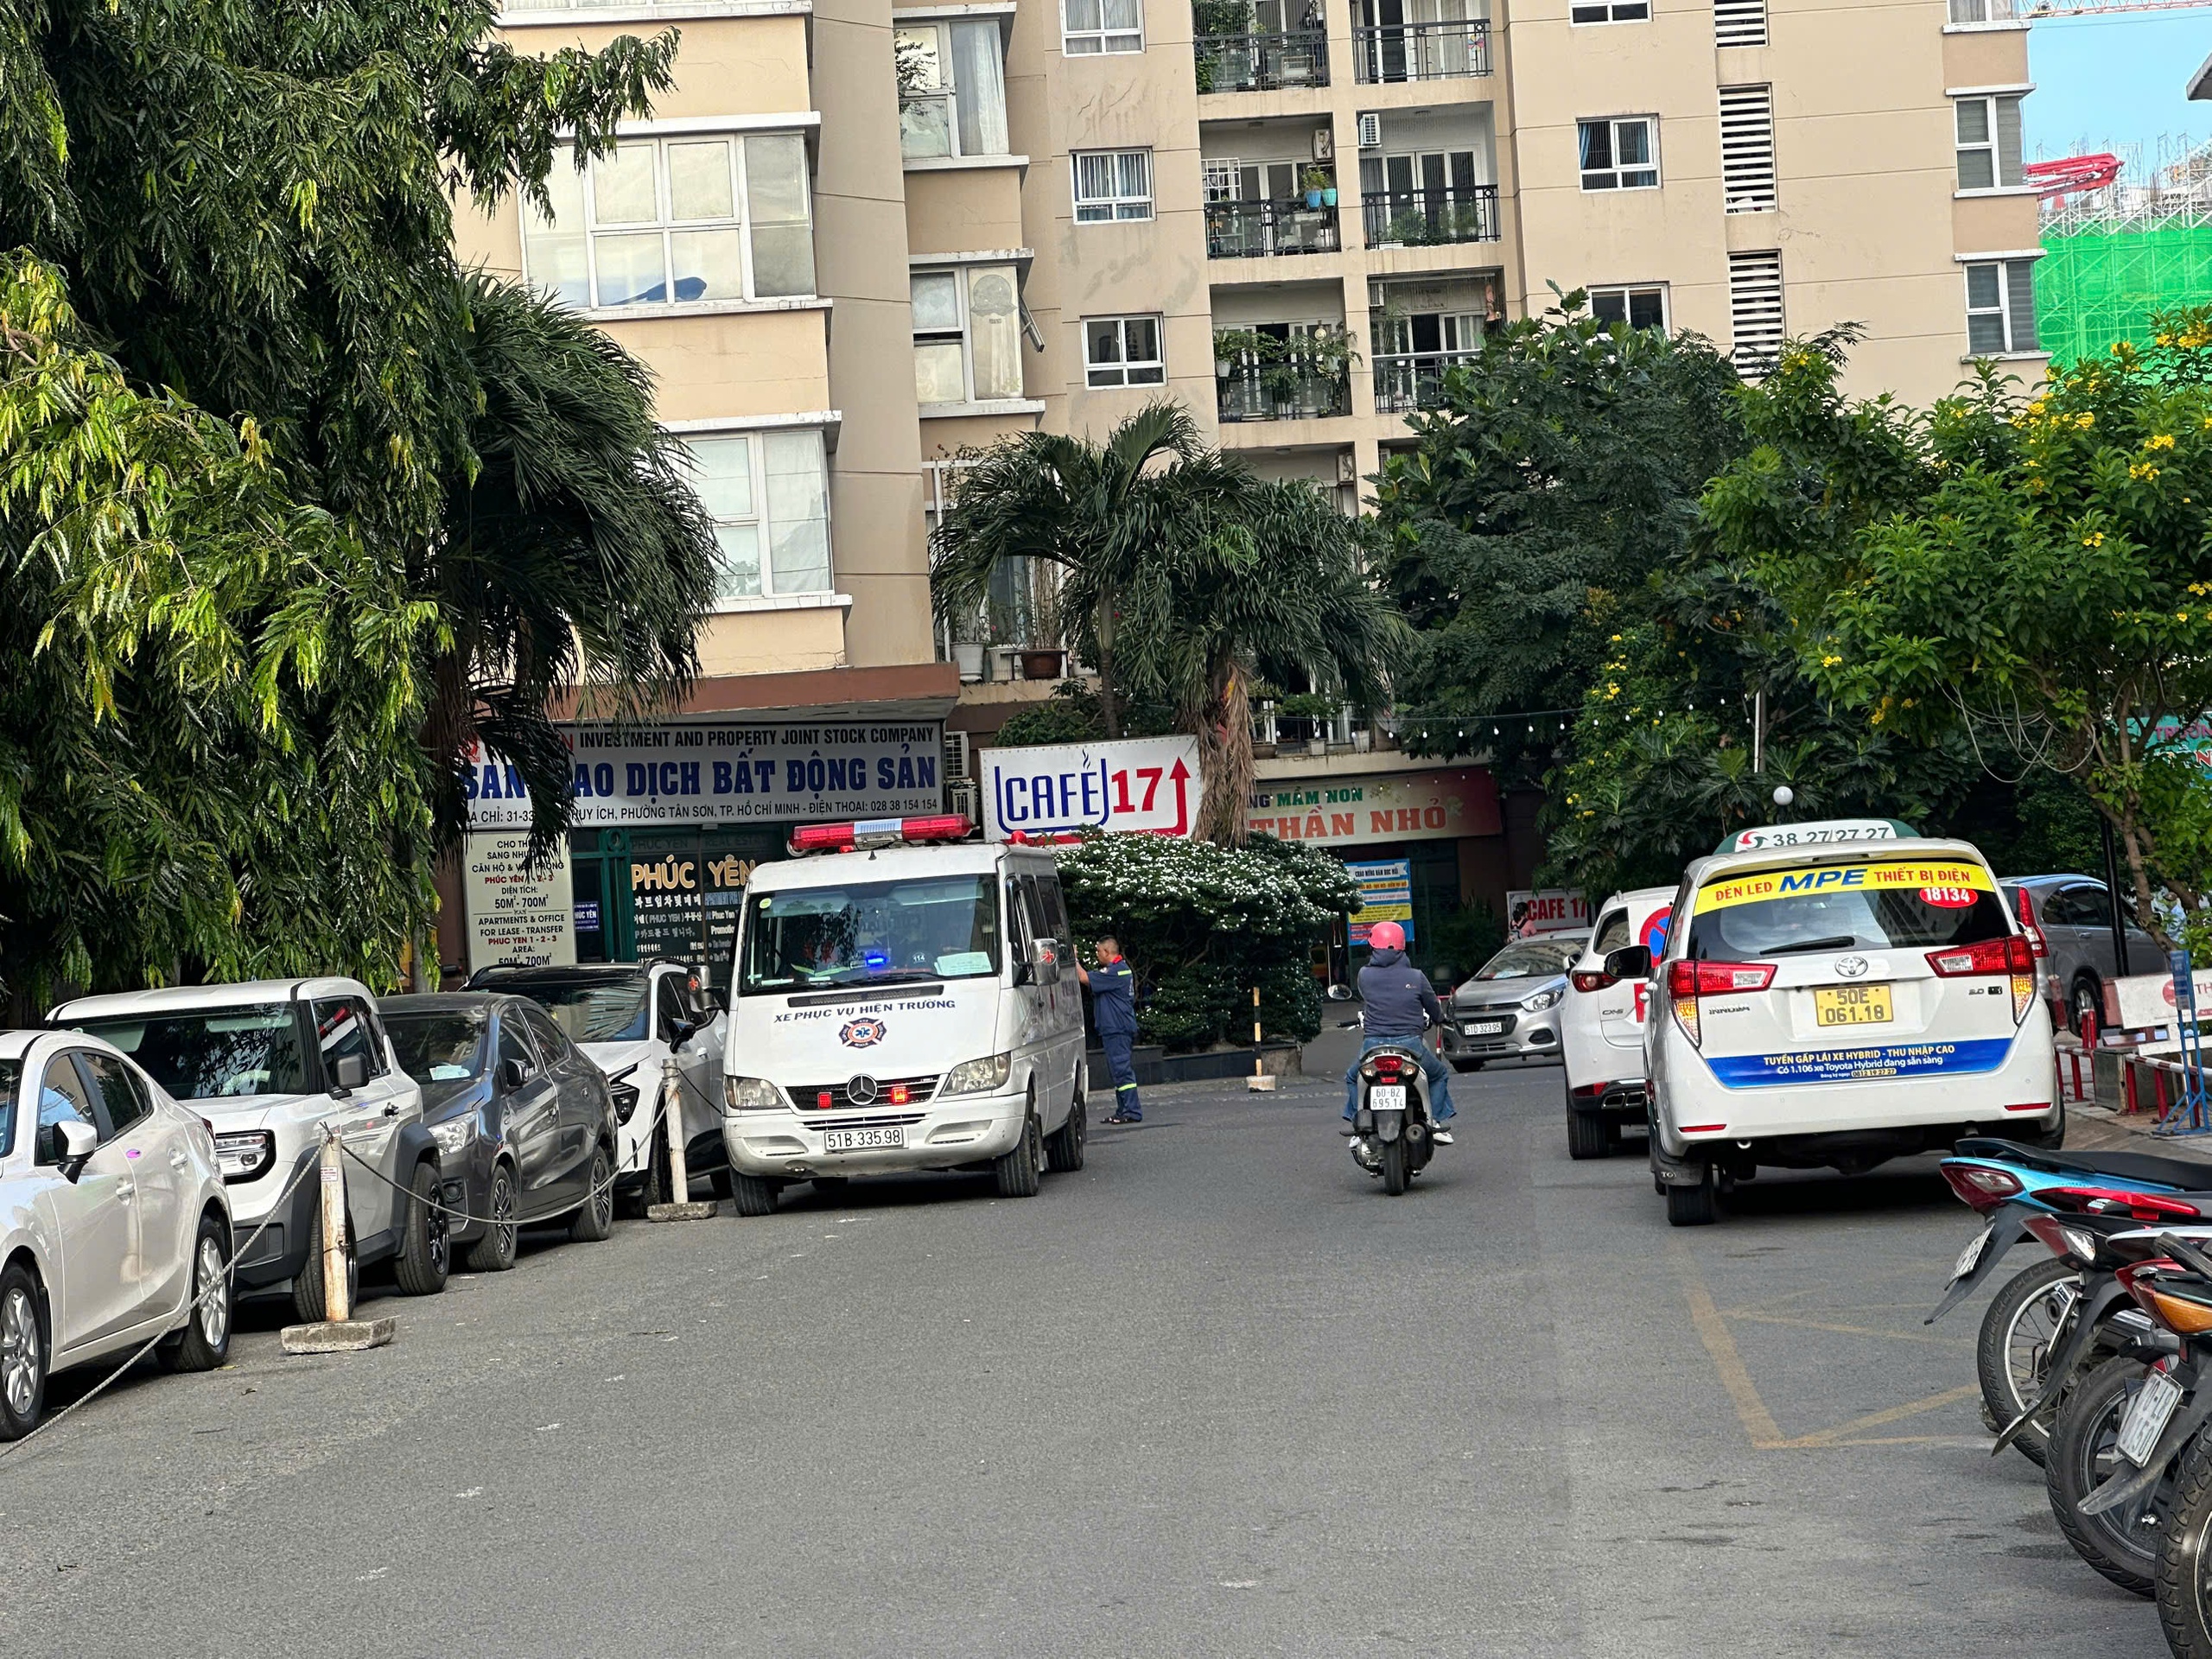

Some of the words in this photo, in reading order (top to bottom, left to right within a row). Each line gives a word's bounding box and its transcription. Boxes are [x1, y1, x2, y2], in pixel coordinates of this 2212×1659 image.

[580, 731, 671, 748] INVESTMENT
[675, 731, 703, 747] AND
[708, 730, 777, 747] PROPERTY
[781, 729, 820, 745] JOINT
[824, 728, 867, 744] STOCK
[870, 727, 934, 742] COMPANY
[626, 761, 701, 804] DỊCH
[713, 747, 776, 794] BẤT
[786, 749, 867, 799] ĐỘNG
[877, 743, 936, 790] SẢN
[1111, 766, 1164, 814] 17
[1325, 787, 1363, 804] NON
[480, 806, 503, 823] CHỈ:
[596, 805, 618, 821] ÍCH,
[621, 804, 665, 820] PHƯỜNG
[669, 804, 690, 818] TÂN
[692, 804, 717, 818] SƠN,
[720, 805, 734, 817] TP.
[737, 800, 753, 816] HỒ
[754, 802, 772, 815] CHÍ
[774, 803, 800, 814] MINH
[809, 799, 832, 815] ĐIỆN
[835, 801, 868, 814] THOẠI:
[871, 800, 887, 811] 028
[889, 800, 900, 811] 38
[903, 799, 919, 810] 154
[922, 799, 938, 810] 154
[1249, 805, 1355, 841] THẦN
[1370, 798, 1446, 834] NHỎ
[497, 840, 516, 849] CHO
[486, 851, 510, 860] SANG
[472, 864, 490, 873] CĂN
[493, 862, 505, 875] HỘ
[631, 854, 696, 892] PHÚC
[707, 854, 757, 887] YÊN
[485, 874, 507, 884] PHÚC
[508, 874, 524, 883] YÊN
[1714, 884, 1744, 901] ĐÈN
[1747, 881, 1773, 895] LED
[1778, 868, 1869, 893] MPE
[1873, 865, 1914, 883] THIẾT
[1919, 869, 1934, 885] BỊ
[1937, 870, 1971, 884] ĐIỆN
[501, 885, 518, 896] DIỆN
[519, 885, 538, 893] TÍCH:
[1923, 888, 1971, 903] 18134
[1527, 898, 1566, 921] CAFE
[478, 916, 528, 925] APARTMENTS
[480, 928, 496, 937] FOR
[499, 927, 520, 936] LEASE
[526, 925, 563, 934] TRANSFER
[488, 937, 511, 945] PHUC
[512, 945, 535, 954] AREA:
[1836, 988, 1870, 1006] 50E
[773, 1014, 792, 1023] XE
[794, 1009, 832, 1020] PHỤC
[836, 1007, 855, 1017] VỤ
[859, 1002, 893, 1014] HIỆN
[897, 999, 956, 1010] TRƯỜNG
[1708, 1007, 1751, 1015] INNOVA
[1825, 1005, 1885, 1023] 061.18
[1816, 1052, 1832, 1062] LÁI
[1833, 1052, 1845, 1061] XE
[1846, 1050, 1881, 1060] HYBRID
[1887, 1048, 1906, 1058] THU
[1936, 1045, 1955, 1054] CAO
[1777, 1065, 1789, 1075] Có
[1790, 1065, 1814, 1073] 1.106
[1825, 1061, 1853, 1071] Toyota
[1854, 1058, 1883, 1071] Hybrid
[1884, 1058, 1906, 1069] đang
[1923, 1054, 1943, 1066] sàng
[828, 1129, 900, 1147] 51B-335.98
